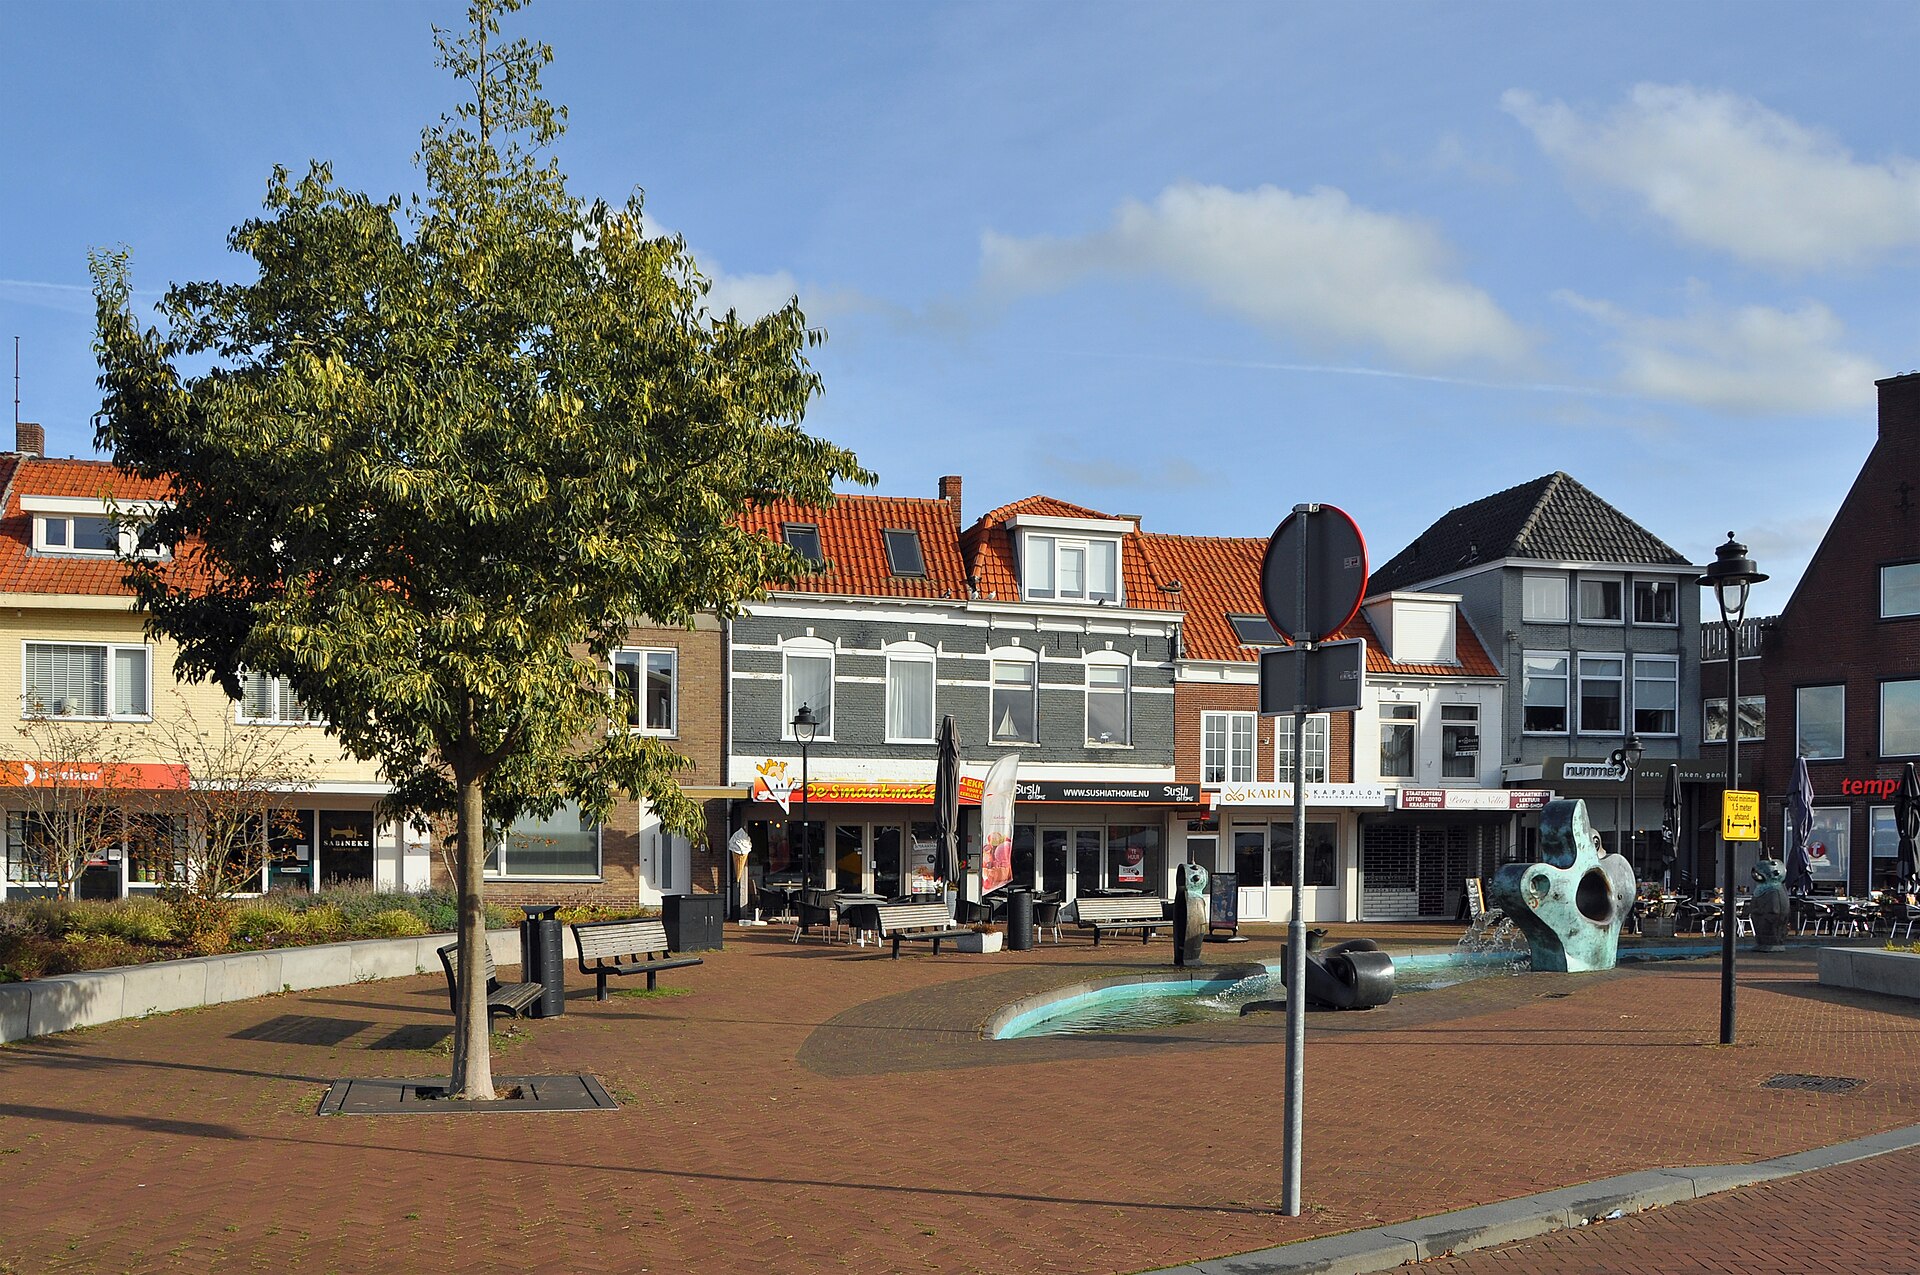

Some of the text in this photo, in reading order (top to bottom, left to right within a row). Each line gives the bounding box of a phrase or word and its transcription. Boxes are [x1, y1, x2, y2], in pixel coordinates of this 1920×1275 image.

[1566, 765, 1619, 777] nummer
[962, 778, 984, 789] LEKK
[807, 783, 936, 799] De Smaakmake
[1063, 788, 1150, 798] WWW.SUSHIATHOME.NU
[1740, 804, 1752, 812] meter
